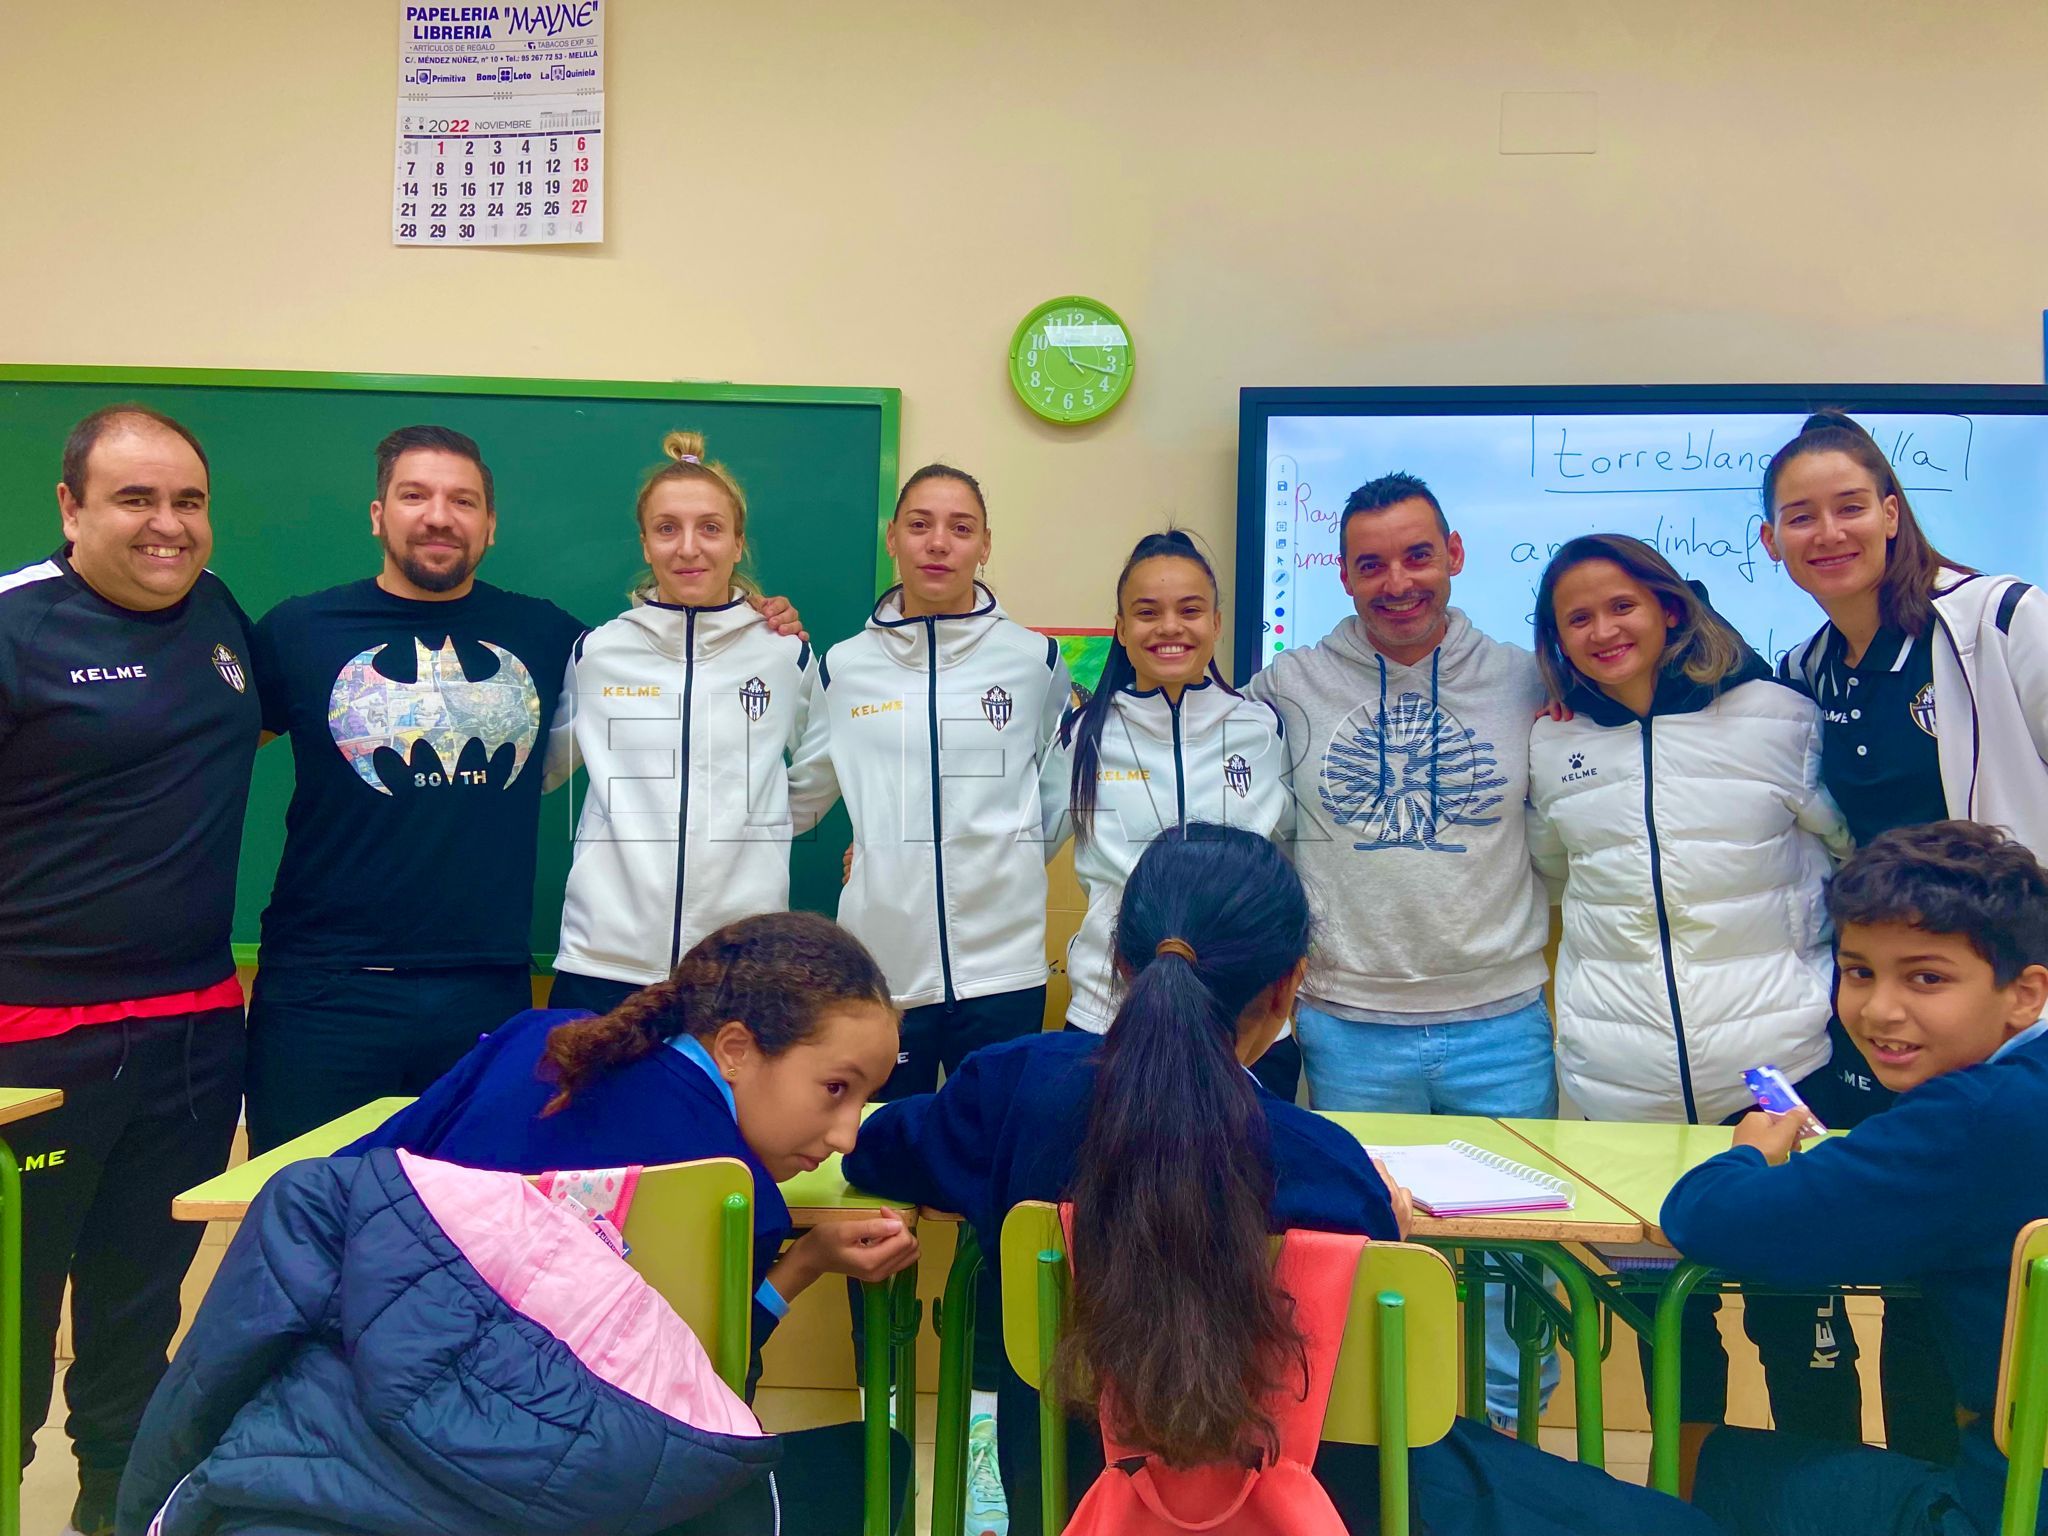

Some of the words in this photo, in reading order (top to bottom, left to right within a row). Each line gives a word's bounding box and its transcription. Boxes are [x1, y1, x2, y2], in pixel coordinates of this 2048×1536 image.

[406, 7, 499, 21] PAPELERIA
[413, 25, 492, 39] LIBRERIA
[467, 43, 496, 51] REGALO
[537, 40, 569, 48] TABACOS
[417, 55, 450, 64] MÉNDEZ
[568, 50, 598, 59] MELILLA
[432, 74, 466, 83] Primitiva
[476, 73, 497, 81] Bono
[513, 72, 532, 80] Loto
[540, 71, 550, 79] La
[565, 68, 596, 78] Quiniela
[429, 119, 470, 133] 2022
[474, 120, 532, 130] NOVIEMBRE
[403, 141, 419, 155] 31
[438, 141, 444, 155] 1
[465, 141, 474, 155] 2
[494, 140, 502, 154] 3
[521, 139, 530, 153] 4
[549, 138, 557, 152] 5
[577, 136, 586, 151] 6
[407, 162, 415, 175] 7
[436, 162, 444, 176] 8
[465, 162, 473, 175] 9
[489, 161, 505, 175] 10
[518, 160, 532, 174] 11
[546, 159, 561, 173] 12
[573, 158, 589, 172] 13
[402, 183, 418, 196] 14
[432, 183, 447, 197] 15
[461, 183, 476, 197] 16
[489, 182, 504, 196] 17
[517, 181, 532, 195] 18
[545, 180, 560, 194] 19
[572, 178, 588, 193] 20
[401, 203, 416, 217] 21
[431, 203, 447, 217] 22
[459, 203, 475, 217] 23
[488, 203, 504, 217] 24
[516, 202, 532, 216] 25
[544, 201, 559, 215] 26
[572, 200, 587, 214] 27
[400, 224, 417, 237] 28
[430, 224, 446, 238] 29
[459, 224, 475, 238] 30
[492, 224, 498, 237] 1
[519, 224, 527, 237] 2
[547, 222, 556, 236] 3
[575, 221, 583, 235] 4
[1067, 313, 1084, 327] 12
[1031, 334, 1049, 350] 10
[1102, 335, 1112, 352] 2
[1027, 350, 1038, 367] 9
[1107, 355, 1116, 372] 3
[1030, 371, 1040, 387] 8
[1100, 375, 1109, 392] 4
[1043, 387, 1055, 403] 7
[1063, 393, 1073, 409] 6
[1083, 389, 1093, 405] 5
[1554, 428, 1772, 478] torreblanc
[70, 665, 147, 683] KELME
[603, 687, 661, 697] KELME
[851, 700, 904, 719] KELME
[414, 772, 442, 788] 80
[459, 770, 487, 785] TH
[1561, 768, 1598, 783] KELME
